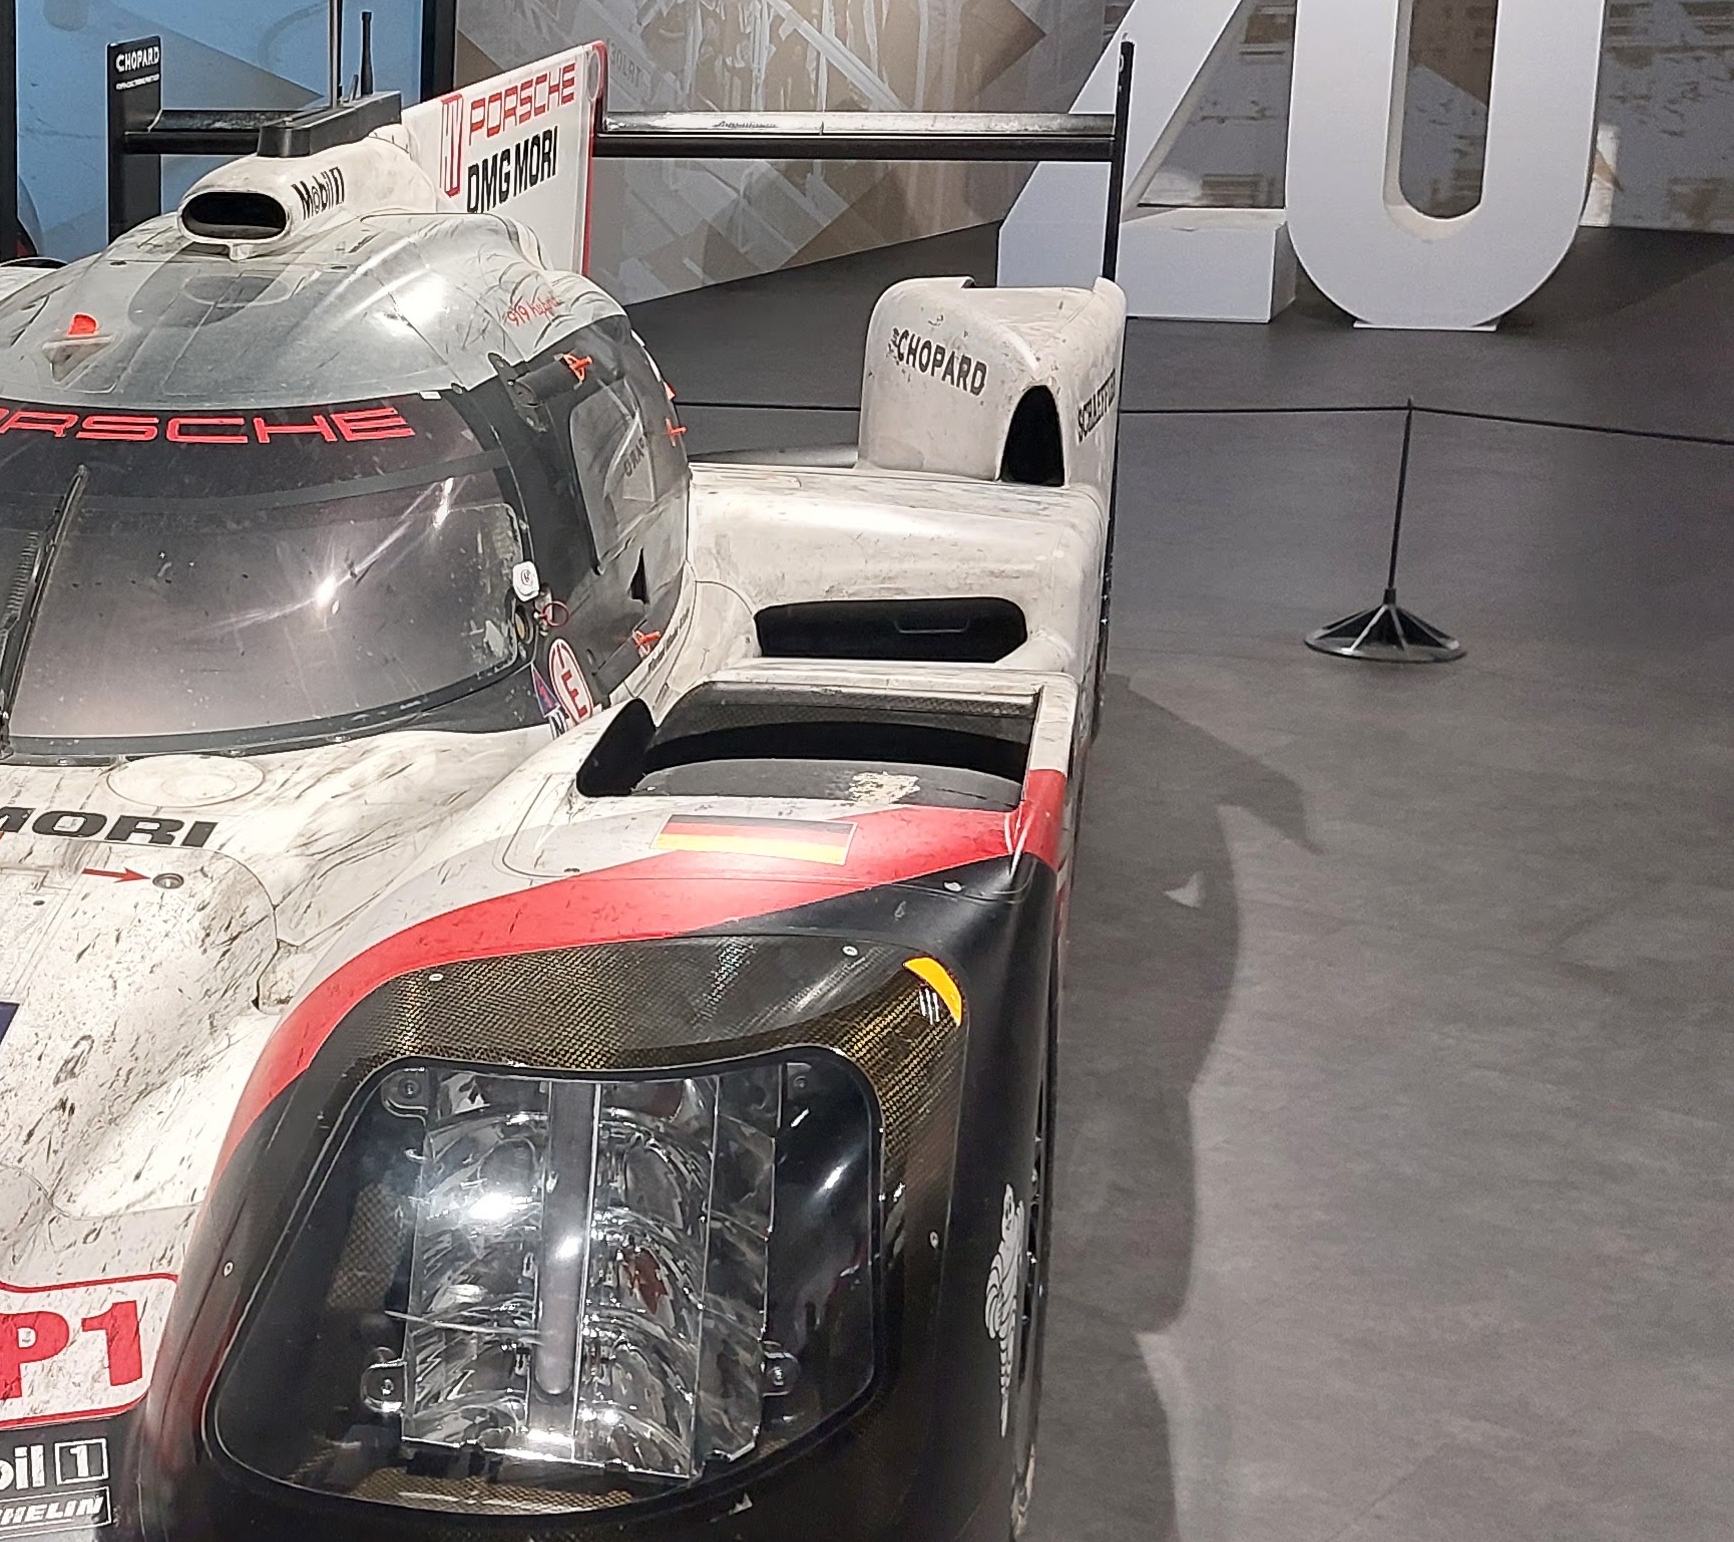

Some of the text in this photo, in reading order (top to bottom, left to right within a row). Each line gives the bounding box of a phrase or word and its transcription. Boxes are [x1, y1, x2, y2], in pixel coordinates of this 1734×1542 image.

[116, 46, 159, 72] CHOPARD
[469, 63, 576, 145] PORSCHE
[467, 126, 558, 213] DMG MORI
[897, 329, 987, 396] CHOPARD
